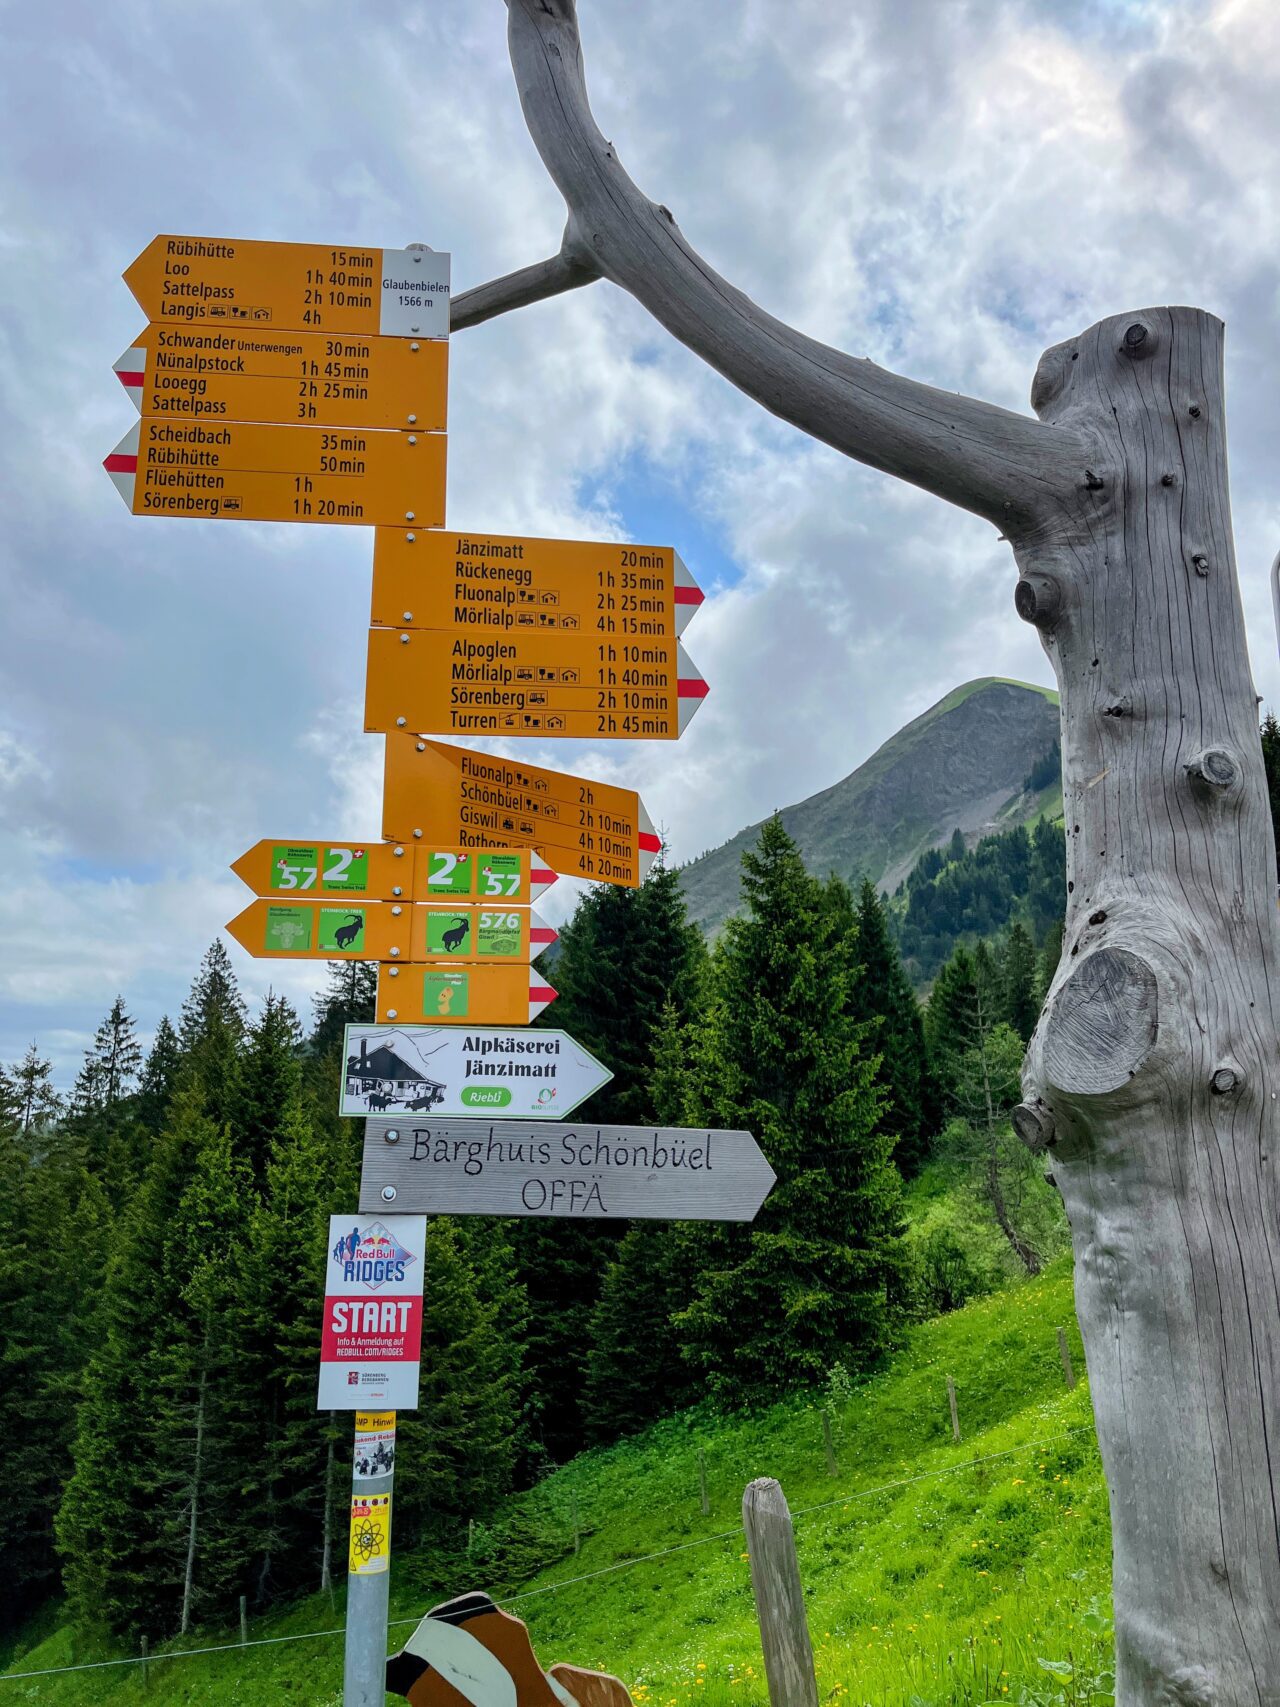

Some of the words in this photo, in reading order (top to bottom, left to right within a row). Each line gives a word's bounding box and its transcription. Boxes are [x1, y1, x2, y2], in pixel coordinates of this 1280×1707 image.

[167, 241, 234, 258] Rübihütte
[165, 260, 189, 275] Loo
[163, 280, 234, 301] Sattelpass
[382, 278, 450, 293] Glaubenbielen
[161, 300, 205, 320] Langis
[399, 296, 422, 307] 1566
[424, 298, 433, 308] m
[158, 331, 236, 350] Schwander
[238, 341, 302, 356] Unterwengen
[156, 352, 244, 372] Nünalpstock
[155, 373, 206, 395] Looegg
[153, 395, 226, 416] Sattelpass
[149, 425, 231, 445] Scheidbach
[148, 447, 219, 467] Rübihütte
[146, 469, 224, 488] Flüehütten
[144, 492, 219, 515] Sörenberg
[456, 539, 523, 559] Jänzimatt
[456, 561, 531, 586] Rückenegg
[455, 583, 516, 607] Fluonalp
[454, 606, 514, 630] Mörlialp
[452, 639, 516, 662] Alpoglen
[451, 663, 513, 686] Mörlialp
[451, 687, 525, 710] Sörenberg
[450, 711, 496, 728] Turren
[461, 757, 514, 788] Fluonalp
[460, 780, 524, 811] Schönbüel
[459, 806, 499, 829] Giswil
[322, 848, 353, 881] 2
[427, 852, 457, 885] 2
[278, 866, 317, 890] 57
[484, 874, 520, 896] 57
[479, 912, 520, 929] 576
[462, 1035, 561, 1056] Alpkäserei
[465, 1059, 558, 1078] Jänzimatt
[409, 1126, 551, 1175] Bärghuis
[561, 1131, 713, 1170] Schönbüel
[522, 1174, 608, 1212] OFFÄ
[344, 1261, 405, 1282] RIDGES
[332, 1302, 413, 1333] START
[337, 1337, 350, 1346] Info
[351, 1337, 356, 1346] &
[357, 1337, 393, 1347] Anmeldung
[393, 1337, 404, 1345] auf
